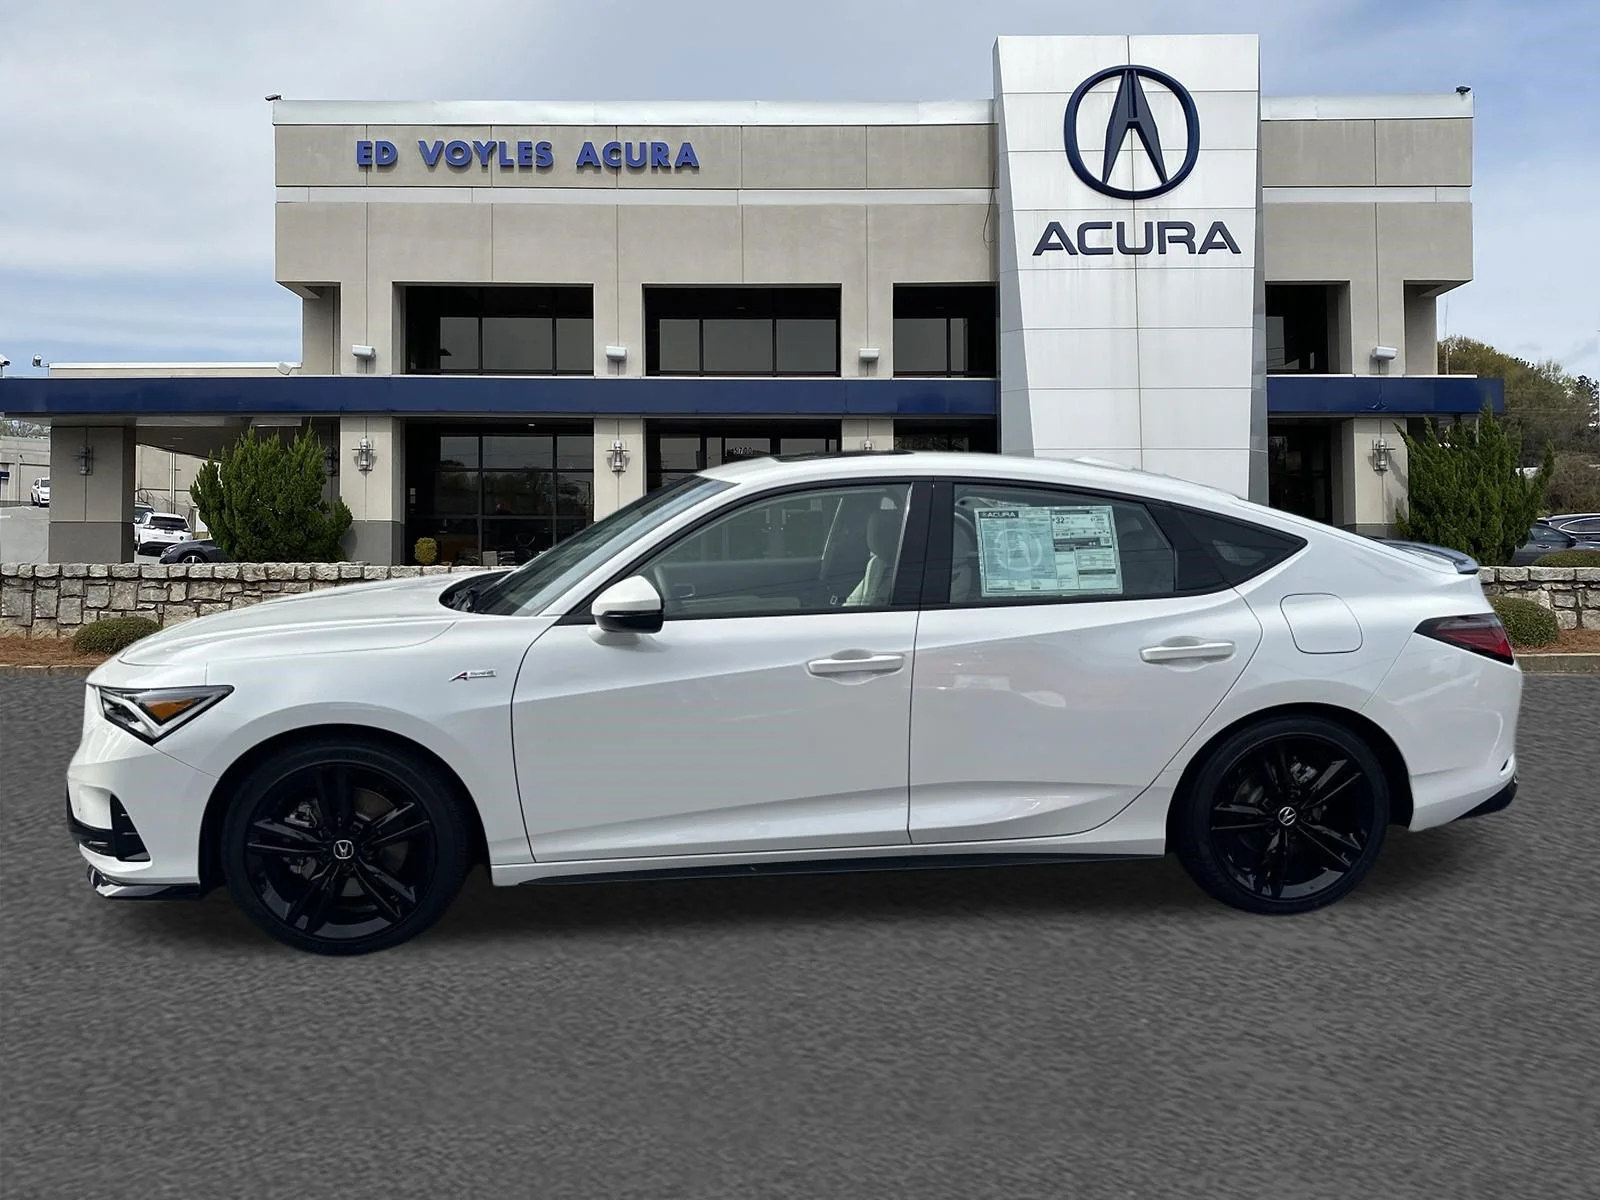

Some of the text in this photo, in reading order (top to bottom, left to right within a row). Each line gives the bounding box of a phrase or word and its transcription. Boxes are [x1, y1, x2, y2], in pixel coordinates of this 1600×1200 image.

[356, 140, 700, 168] ED VOYLES ACURA
[1032, 221, 1242, 256] ACURA
